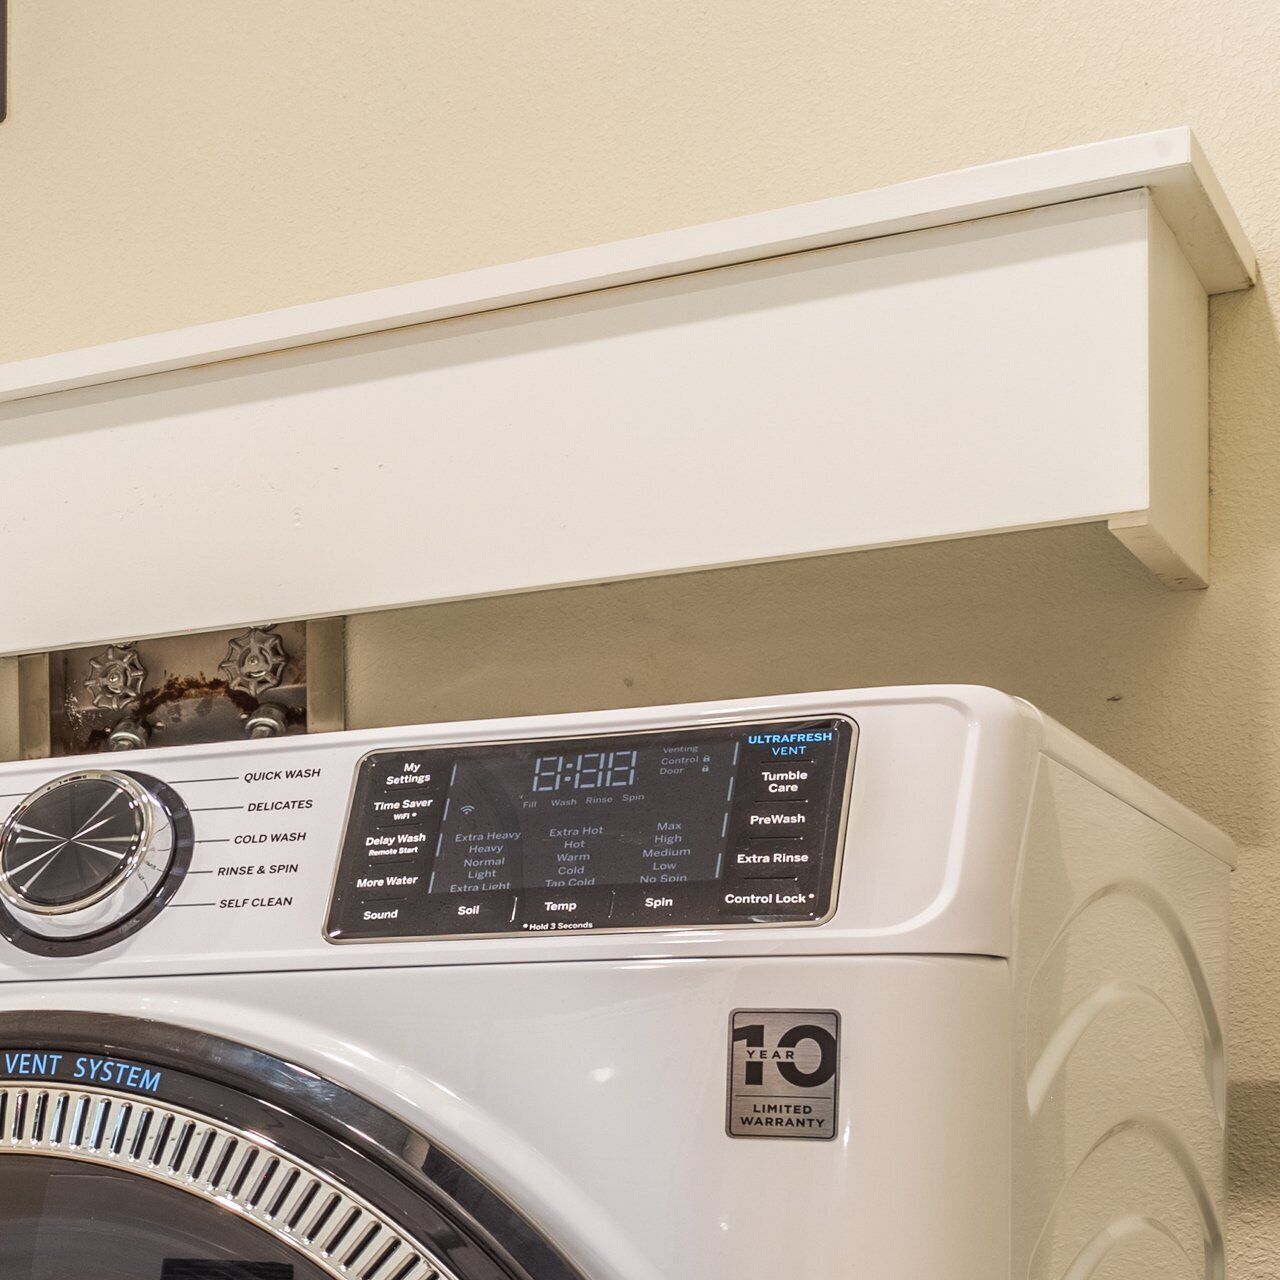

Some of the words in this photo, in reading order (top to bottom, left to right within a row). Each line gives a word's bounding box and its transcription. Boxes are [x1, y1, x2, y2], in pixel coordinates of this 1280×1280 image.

[748, 732, 832, 745] ULTRAFRESH
[771, 745, 807, 756] VENT
[661, 755, 699, 765] Control
[404, 762, 421, 773] My
[659, 767, 685, 775] Door
[243, 771, 282, 783] QUICK
[285, 768, 321, 779] WASH
[386, 774, 431, 785] Settings
[762, 770, 808, 781] Tumble
[768, 783, 798, 793] Care
[247, 799, 313, 812] DELICATES
[374, 801, 400, 811] Time
[402, 799, 434, 809] Saver
[522, 801, 537, 809] Fill
[551, 798, 577, 807] Wash
[585, 796, 613, 805] Rinse
[622, 793, 645, 803] Spin
[750, 813, 805, 825] PreWash
[549, 828, 579, 837] Extra
[582, 826, 604, 835] Hot
[657, 822, 682, 831] Max
[234, 834, 267, 845] COLD
[270, 832, 307, 843] WASH
[365, 836, 396, 847] Delay
[397, 833, 426, 843] Wash
[455, 833, 484, 842] Extra
[486, 832, 521, 841] Heavy
[654, 834, 682, 844] High
[469, 845, 503, 854] Heavy
[564, 840, 585, 849] Hot
[368, 848, 397, 857] Remote
[398, 846, 418, 856] Start
[642, 847, 691, 857] Medium
[463, 857, 505, 867] Normal
[557, 853, 590, 862] Warm
[737, 854, 770, 864] Extra
[773, 852, 809, 863] Rinse
[217, 865, 254, 876] RINSE
[257, 865, 266, 875] &
[269, 864, 299, 874] SPIN
[558, 866, 585, 875] Cold
[653, 861, 677, 871] Low
[468, 869, 496, 880] Light
[640, 875, 657, 884] No
[660, 873, 687, 883] Spin
[356, 877, 387, 888] More
[388, 875, 418, 886] Water
[568, 878, 595, 887] Cold
[449, 884, 479, 893] Extra
[482, 882, 511, 891] Light
[219, 898, 250, 909] SELF
[251, 896, 293, 907] CLEAN
[644, 897, 673, 909] Spin
[724, 893, 773, 904] Control
[776, 893, 806, 904] Lock
[458, 905, 480, 916] Soil
[544, 901, 577, 912] Temp
[363, 909, 398, 921] Sound
[557, 922, 593, 930] Seconds
[733, 1024, 836, 1088] 10
[746, 1050, 794, 1060] YEAR
[5, 1053, 62, 1075] VENT
[73, 1056, 162, 1092] SYSTEM
[753, 1104, 813, 1115] LIMITED
[740, 1116, 825, 1128] WARRANTY
